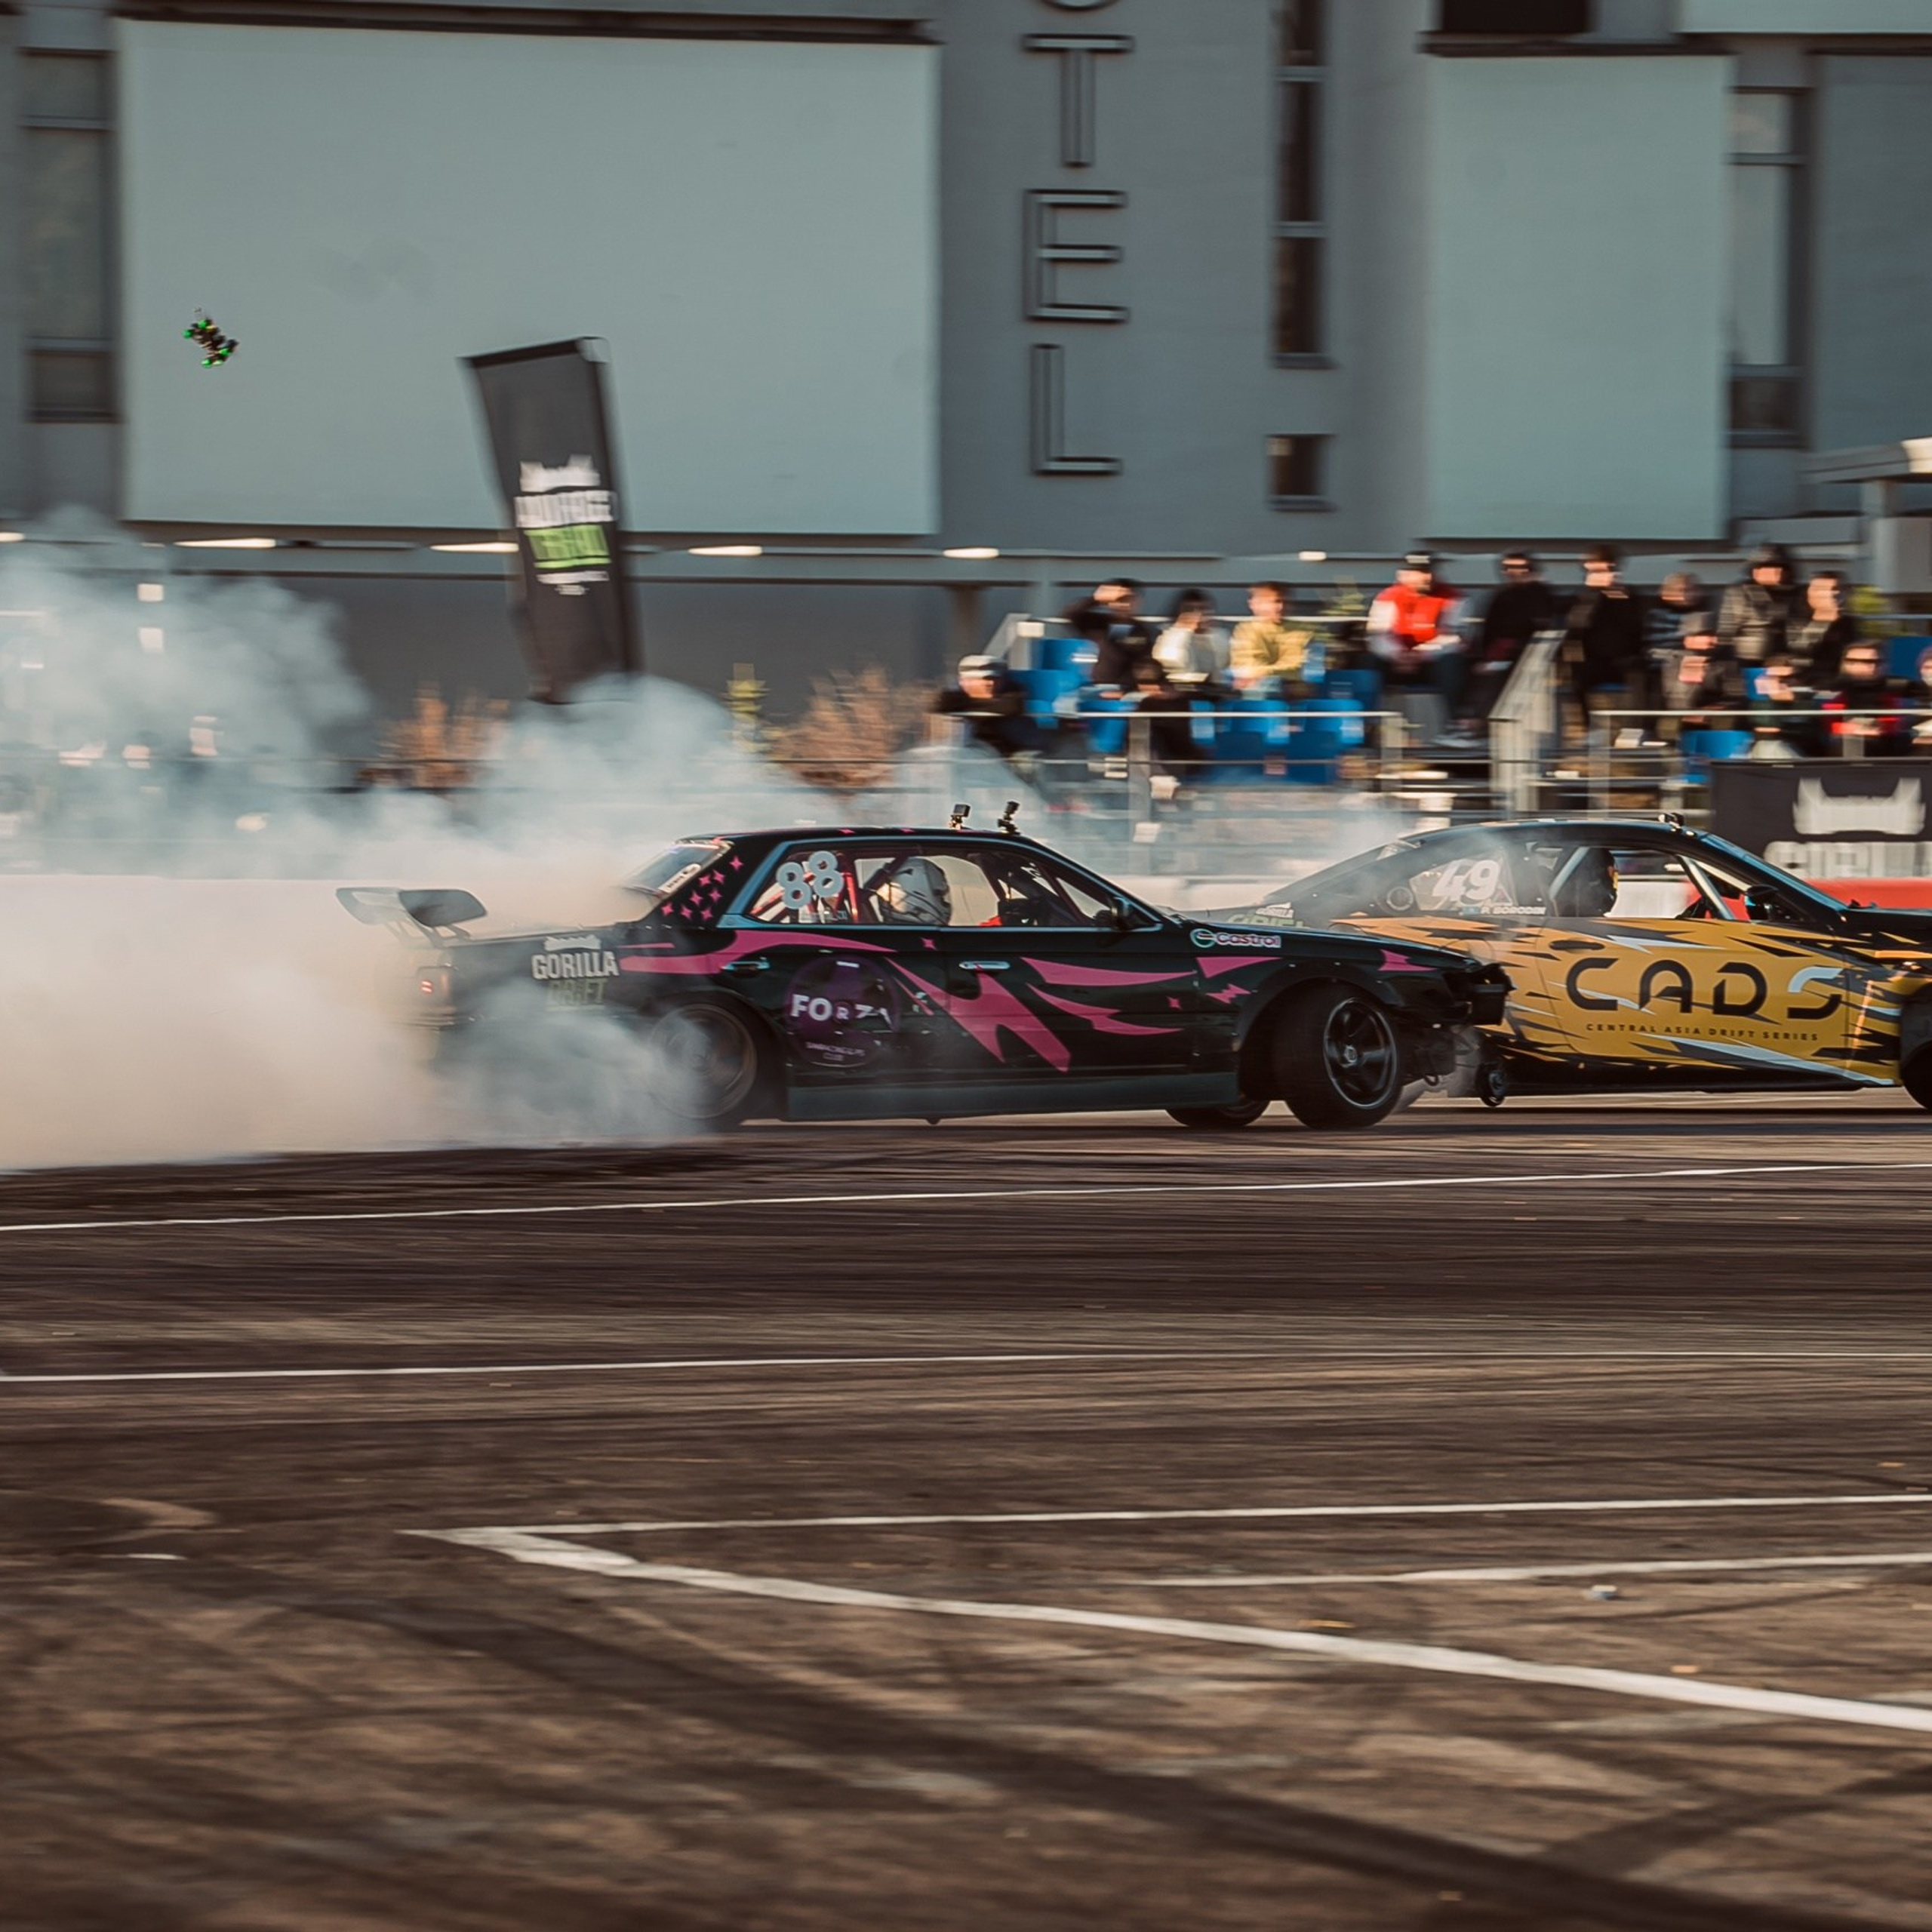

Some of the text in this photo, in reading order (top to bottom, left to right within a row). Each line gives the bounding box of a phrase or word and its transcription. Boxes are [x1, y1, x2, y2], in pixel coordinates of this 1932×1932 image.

[1021, 0, 1134, 477] TEL
[776, 851, 844, 909] 88
[1432, 860, 1501, 902] 49
[1217, 932, 1281, 948] Castrol
[532, 951, 620, 980] GORILLA
[1566, 957, 1844, 1020] CADS
[1586, 1023, 1819, 1041] CENTRAL ASIA DRIFT SERIES
